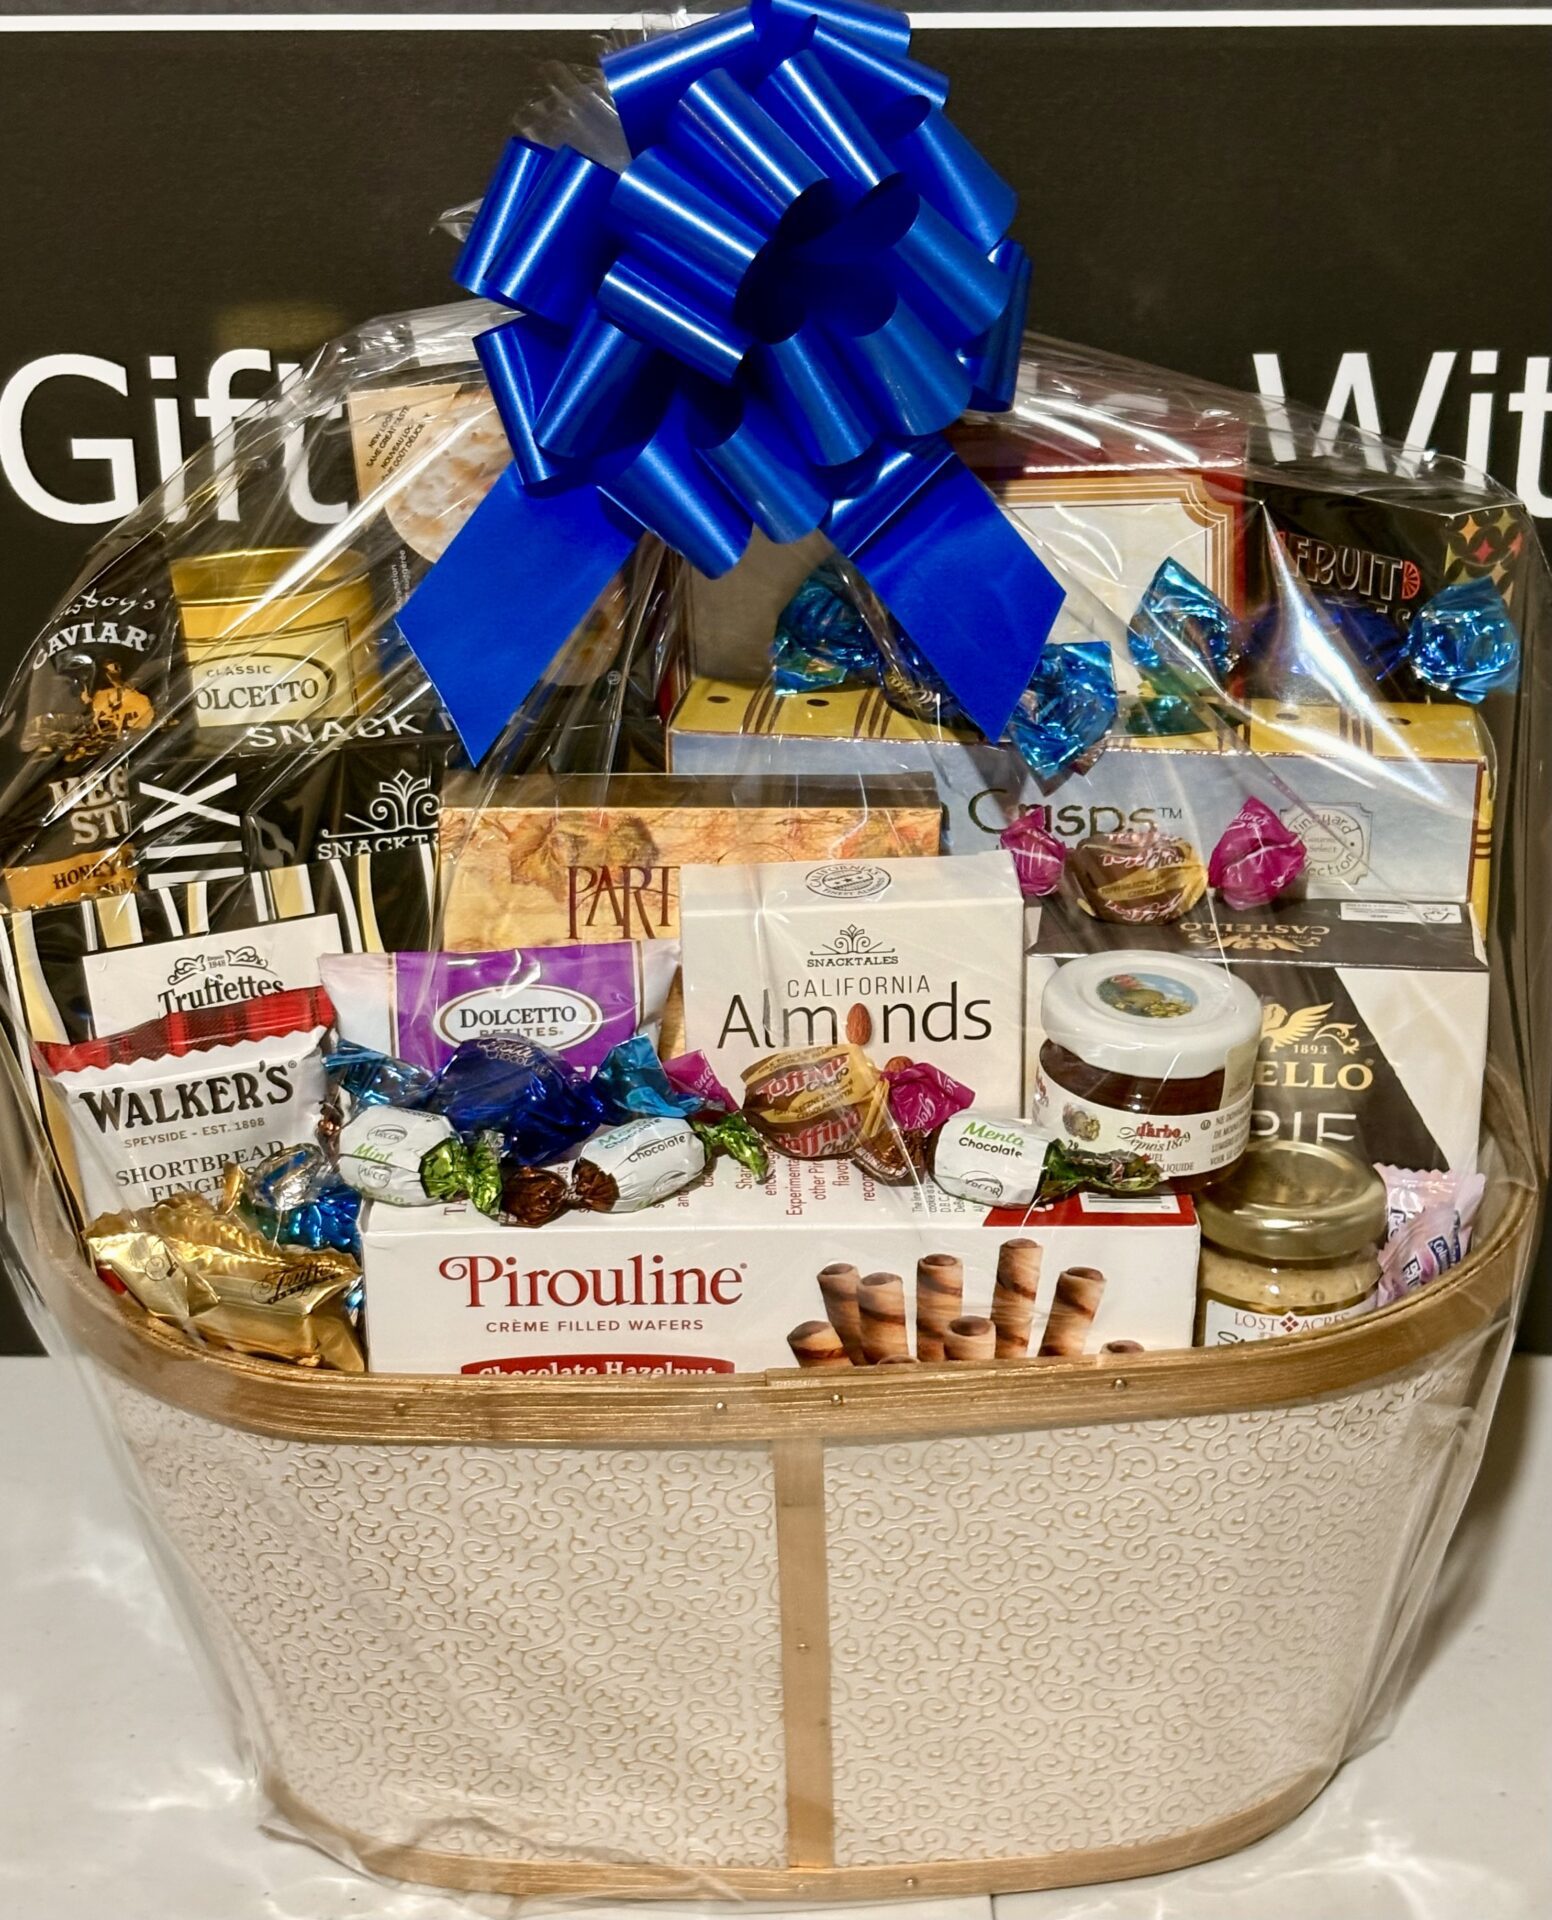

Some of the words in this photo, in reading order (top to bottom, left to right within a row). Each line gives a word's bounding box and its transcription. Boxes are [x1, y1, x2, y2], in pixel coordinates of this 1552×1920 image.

[1289, 532, 1404, 601] FRUIT
[54, 588, 156, 624] wboy's
[206, 664, 272, 678] CLASSIC
[194, 678, 319, 710] OLCETTO
[248, 714, 424, 748] SNACK
[318, 833, 439, 860] SNACKT
[1180, 921, 1330, 936] CASTELLO
[806, 956, 899, 968] SNACKTALES
[158, 974, 285, 1014] Truffettes
[787, 975, 931, 998] CALIFORNIA
[460, 1006, 577, 1028] DOLCETTO
[1293, 1044, 1328, 1055] 1893
[1255, 1060, 1374, 1091] ELLO
[79, 1060, 295, 1134] WALKER'S
[124, 1130, 188, 1149] SPEYSIDE
[203, 1125, 231, 1137] EST.
[235, 1117, 266, 1132] 1898
[963, 1120, 1025, 1148] Menta
[627, 1134, 687, 1164] Chocolate
[959, 1137, 1023, 1158] Chocolate
[814, 1174, 827, 1201] other
[439, 1253, 742, 1308] Pirouline
[486, 1318, 550, 1333] CRÈME
[557, 1320, 620, 1332] FILLED
[628, 1319, 704, 1331] WAFERS
[1234, 1312, 1280, 1332] LOST
